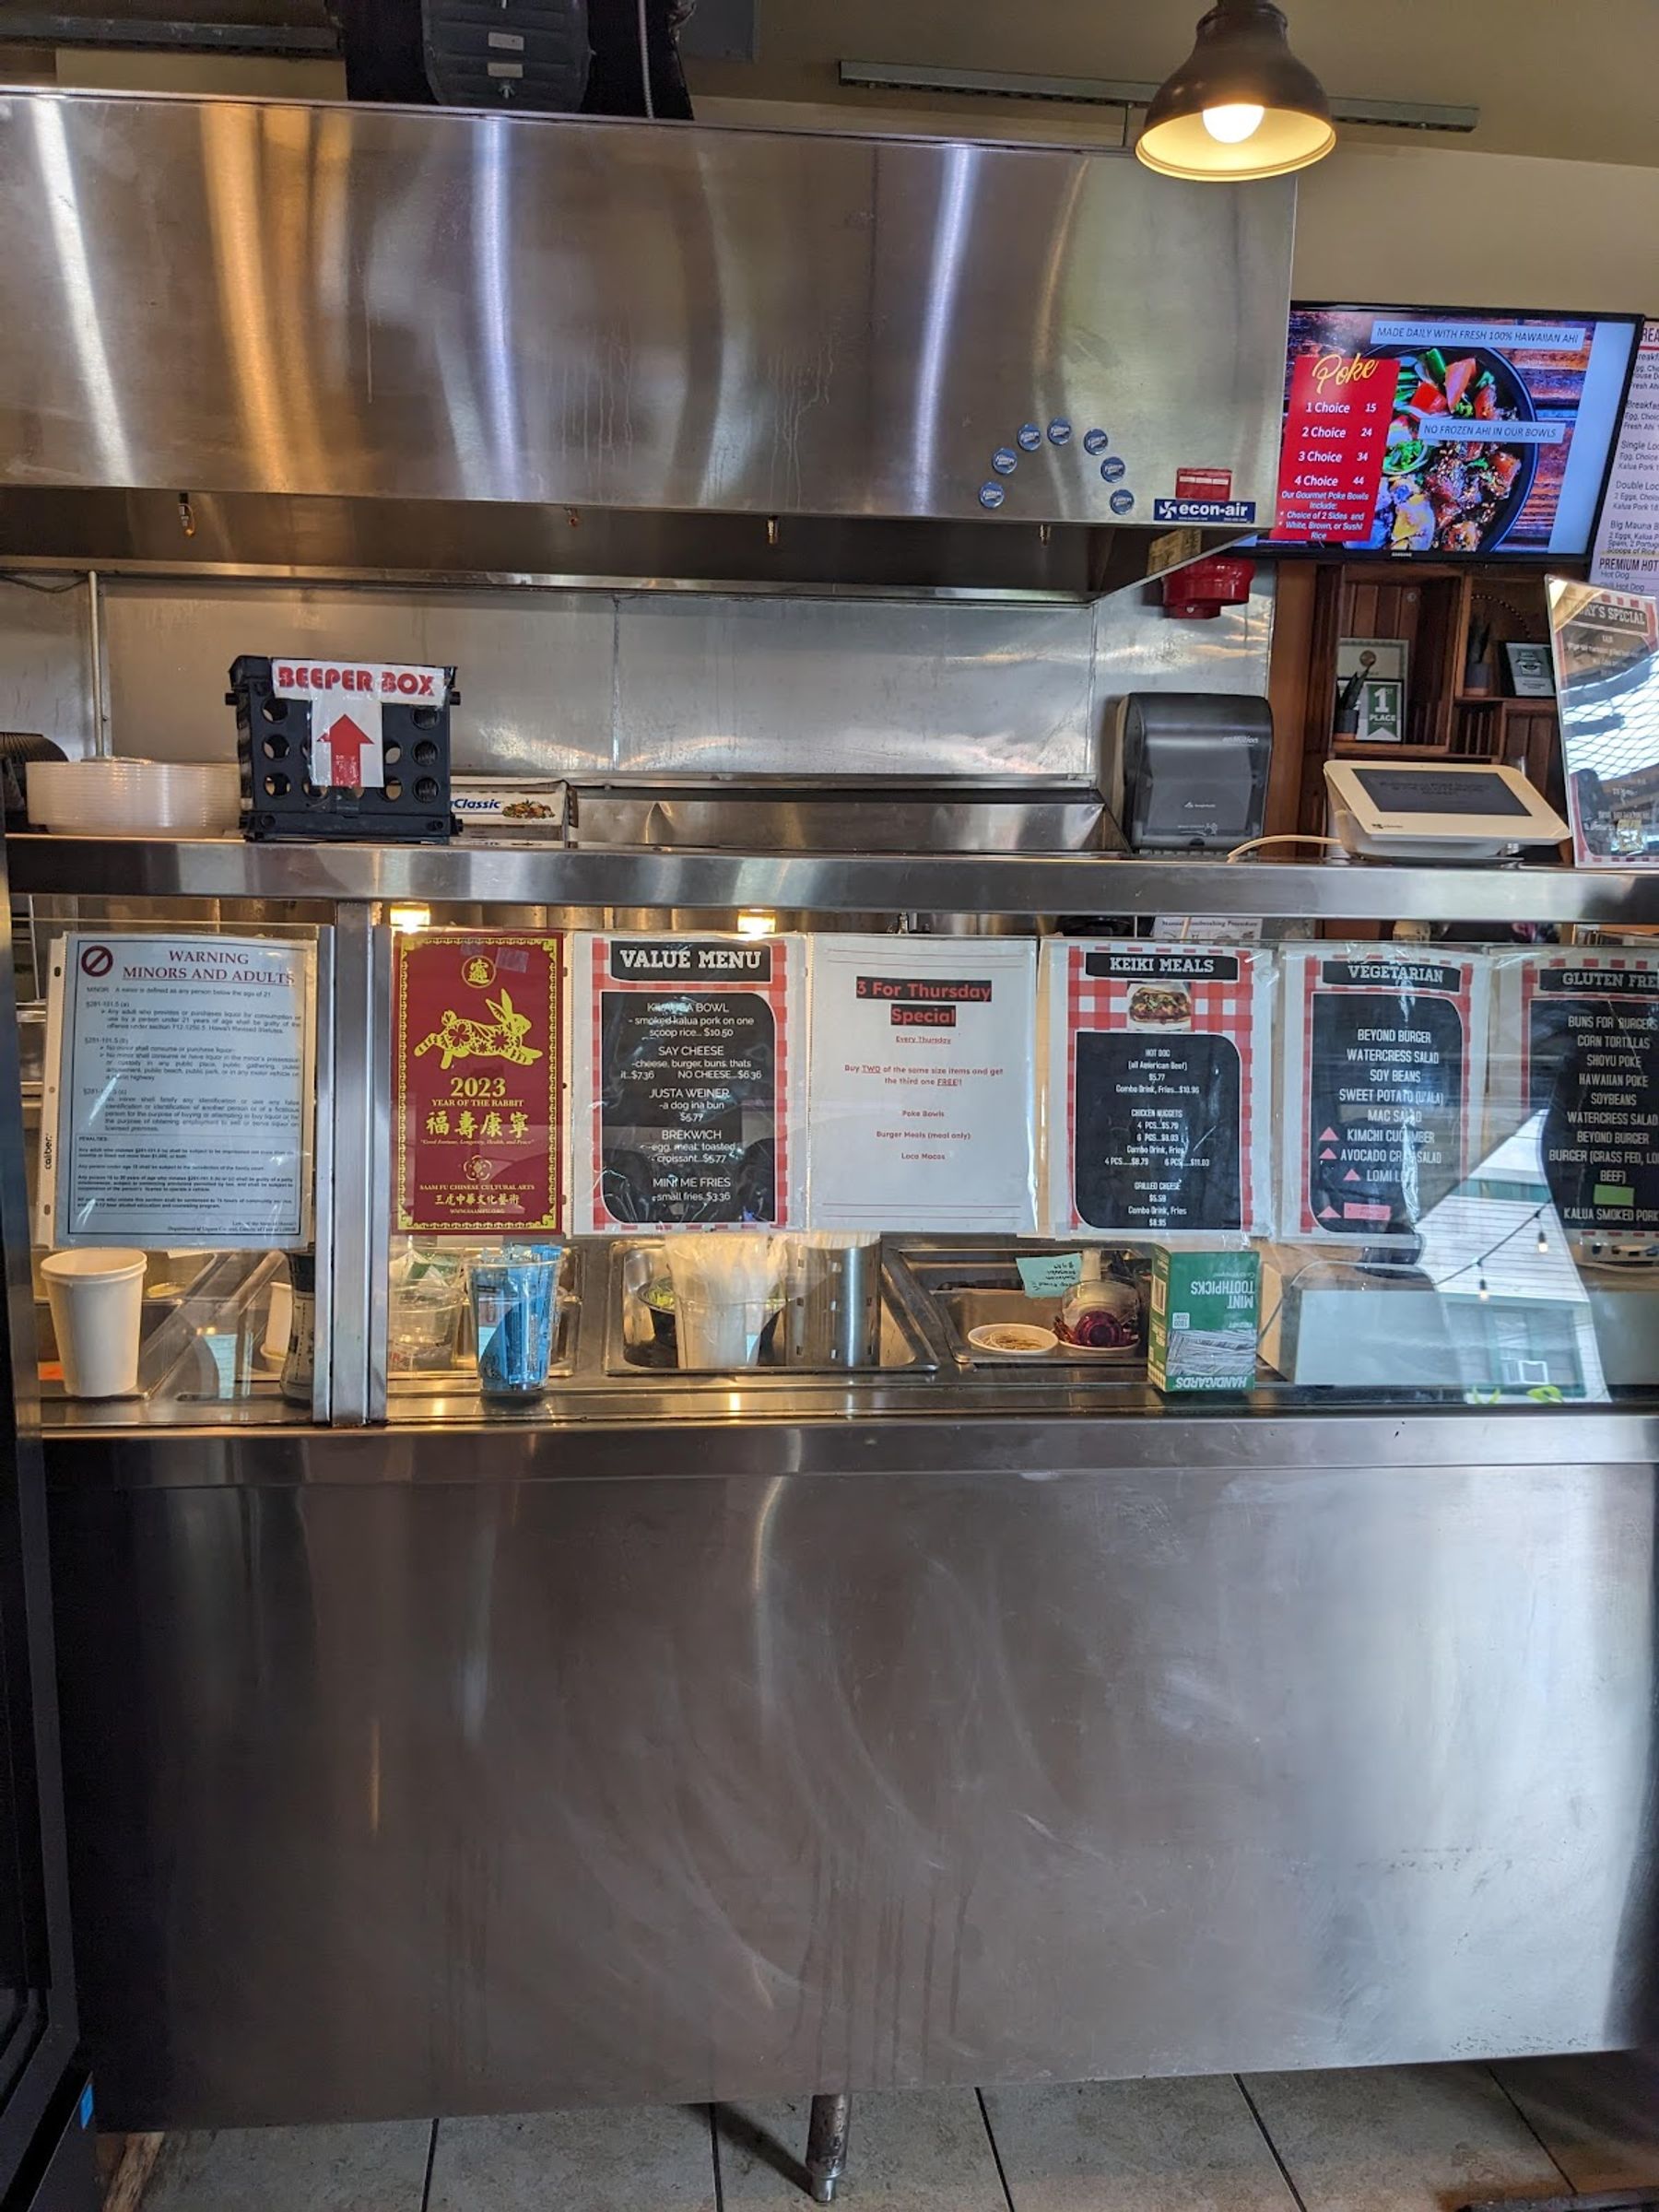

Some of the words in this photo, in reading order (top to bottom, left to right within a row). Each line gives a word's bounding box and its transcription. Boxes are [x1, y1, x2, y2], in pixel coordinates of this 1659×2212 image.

[1378, 327, 1404, 337] MADE
[1406, 329, 1430, 338] DAILY
[1433, 329, 1457, 338] WITH
[1460, 330, 1487, 340] FRESH
[1489, 332, 1512, 341] 100%
[1515, 332, 1559, 343] HAWAIIAN
[1563, 333, 1578, 343] AHI
[1312, 353, 1378, 394] Poke
[1306, 403, 1312, 412] 1
[1315, 403, 1350, 413] Choice
[1365, 404, 1376, 412] 15
[1302, 428, 1309, 437] 2
[1312, 428, 1346, 438] Choice
[1360, 429, 1371, 437] 24
[1424, 425, 1438, 433] NO
[1440, 426, 1474, 435] FROZEN
[1476, 427, 1491, 435] AHI
[1504, 428, 1523, 436] OUR
[1525, 429, 1556, 437] BOWLS
[1621, 441, 1645, 451] Single
[1299, 452, 1305, 461] 3
[1307, 452, 1342, 462] Choice
[1357, 453, 1368, 461] 34
[1295, 477, 1301, 485] 4
[1304, 477, 1338, 486] Choice
[1353, 477, 1364, 485] 44
[1616, 481, 1643, 490] Double
[1297, 492, 1326, 500] Gourmet
[1347, 492, 1368, 500] Bowls
[1180, 503, 1247, 516] econ-air
[1610, 521, 1623, 530] Big
[1625, 521, 1652, 530] Mauna
[1599, 558, 1639, 571] PREMIUM
[1616, 571, 1630, 580] Dog
[1607, 607, 1645, 625] SPECIAL
[278, 666, 372, 691] BEEPER
[382, 672, 435, 696] BOX
[1370, 713, 1396, 722] PLACE
[169, 950, 249, 964] WARNING
[619, 949, 691, 968] VALUE
[699, 951, 761, 969] MENU
[1110, 958, 1154, 971] KEIKI
[1159, 959, 1214, 972] MEALS
[123, 967, 186, 978] MINORS
[192, 969, 227, 980] AND
[232, 971, 295, 984] ADULTS
[1348, 966, 1443, 982] VEGETARIAN
[1563, 972, 1623, 986] GLUTEN
[856, 982, 866, 995] 3
[873, 982, 901, 996] For
[908, 983, 991, 1002] Thursday
[696, 1003, 729, 1012] BOWL
[700, 1017, 721, 1026] pork
[891, 1007, 955, 1024] Special
[1569, 1016, 1594, 1028] BUNS
[1596, 1017, 1613, 1029] FOR
[1618, 1018, 1658, 1030] BURGERS
[650, 1030, 677, 1038] scoop
[704, 1029, 733, 1038] $10.50
[1358, 1030, 1395, 1041] BEYOND
[1398, 1030, 1430, 1043] BURGER
[1578, 1035, 1602, 1047] CORN
[1606, 1036, 1650, 1049] TORTILLAS
[659, 1046, 678, 1055] SAY
[681, 1046, 724, 1055] CHEESE
[1347, 1049, 1411, 1062] WATERCRESS
[1414, 1052, 1439, 1064] SALAD
[729, 1060, 751, 1068] thats
[1587, 1054, 1617, 1066] SHOYU
[1619, 1056, 1641, 1068] POKE
[862, 1065, 881, 1074] TWO
[990, 1068, 1003, 1077] get
[1370, 1069, 1389, 1081] SOY
[1392, 1070, 1420, 1083] BEANS
[1579, 1073, 1622, 1086] HAWAIIAN
[1626, 1075, 1649, 1088] POKE
[451, 1077, 506, 1098] 2023
[649, 1088, 683, 1099] JUSTA
[686, 1089, 730, 1099] WEINER
[1116, 1085, 1137, 1093] Combo
[1139, 1085, 1158, 1094] Drink,
[1339, 1088, 1372, 1101] SWEET
[1377, 1089, 1413, 1102] POTATO
[1591, 1093, 1637, 1105] SOYBEANS
[671, 1100, 688, 1110] dog
[707, 1100, 724, 1110] bun
[1131, 1109, 1155, 1117] CHICKEN
[1157, 1110, 1182, 1118] NUGGETS
[1368, 1110, 1391, 1122] MAC
[1567, 1112, 1629, 1124] WATERCRESS
[1630, 1113, 1658, 1125] SALAD
[662, 1130, 722, 1140] BREKWICH
[1347, 1129, 1382, 1141] KIMCHI
[1577, 1131, 1612, 1143] BEYOND
[1615, 1133, 1649, 1145] BURGER
[701, 1142, 735, 1151] toasted
[1340, 1149, 1386, 1161] AVOCADO
[1418, 1152, 1441, 1163] SALAD
[1549, 1149, 1587, 1161] BURGER
[1590, 1150, 1622, 1164] (GRASS
[1625, 1152, 1643, 1165] FED,
[1367, 1170, 1393, 1182] LOMI
[1600, 1171, 1626, 1183] BEEF)
[653, 1178, 677, 1187] MINI
[681, 1178, 698, 1187] ME
[700, 1178, 731, 1187] FRIES
[1135, 1182, 1158, 1190] GRILLED
[1128, 1206, 1149, 1215] Combo
[1151, 1206, 1169, 1216] Drink,
[1171, 1206, 1187, 1215] Fries
[1564, 1207, 1594, 1220] KALUA
[1596, 1209, 1633, 1220] SMOKED
[1636, 1210, 1659, 1221] PORK
[1191, 1281, 1255, 1295] TOOTHPICKS
[1227, 1296, 1253, 1309] MINT
